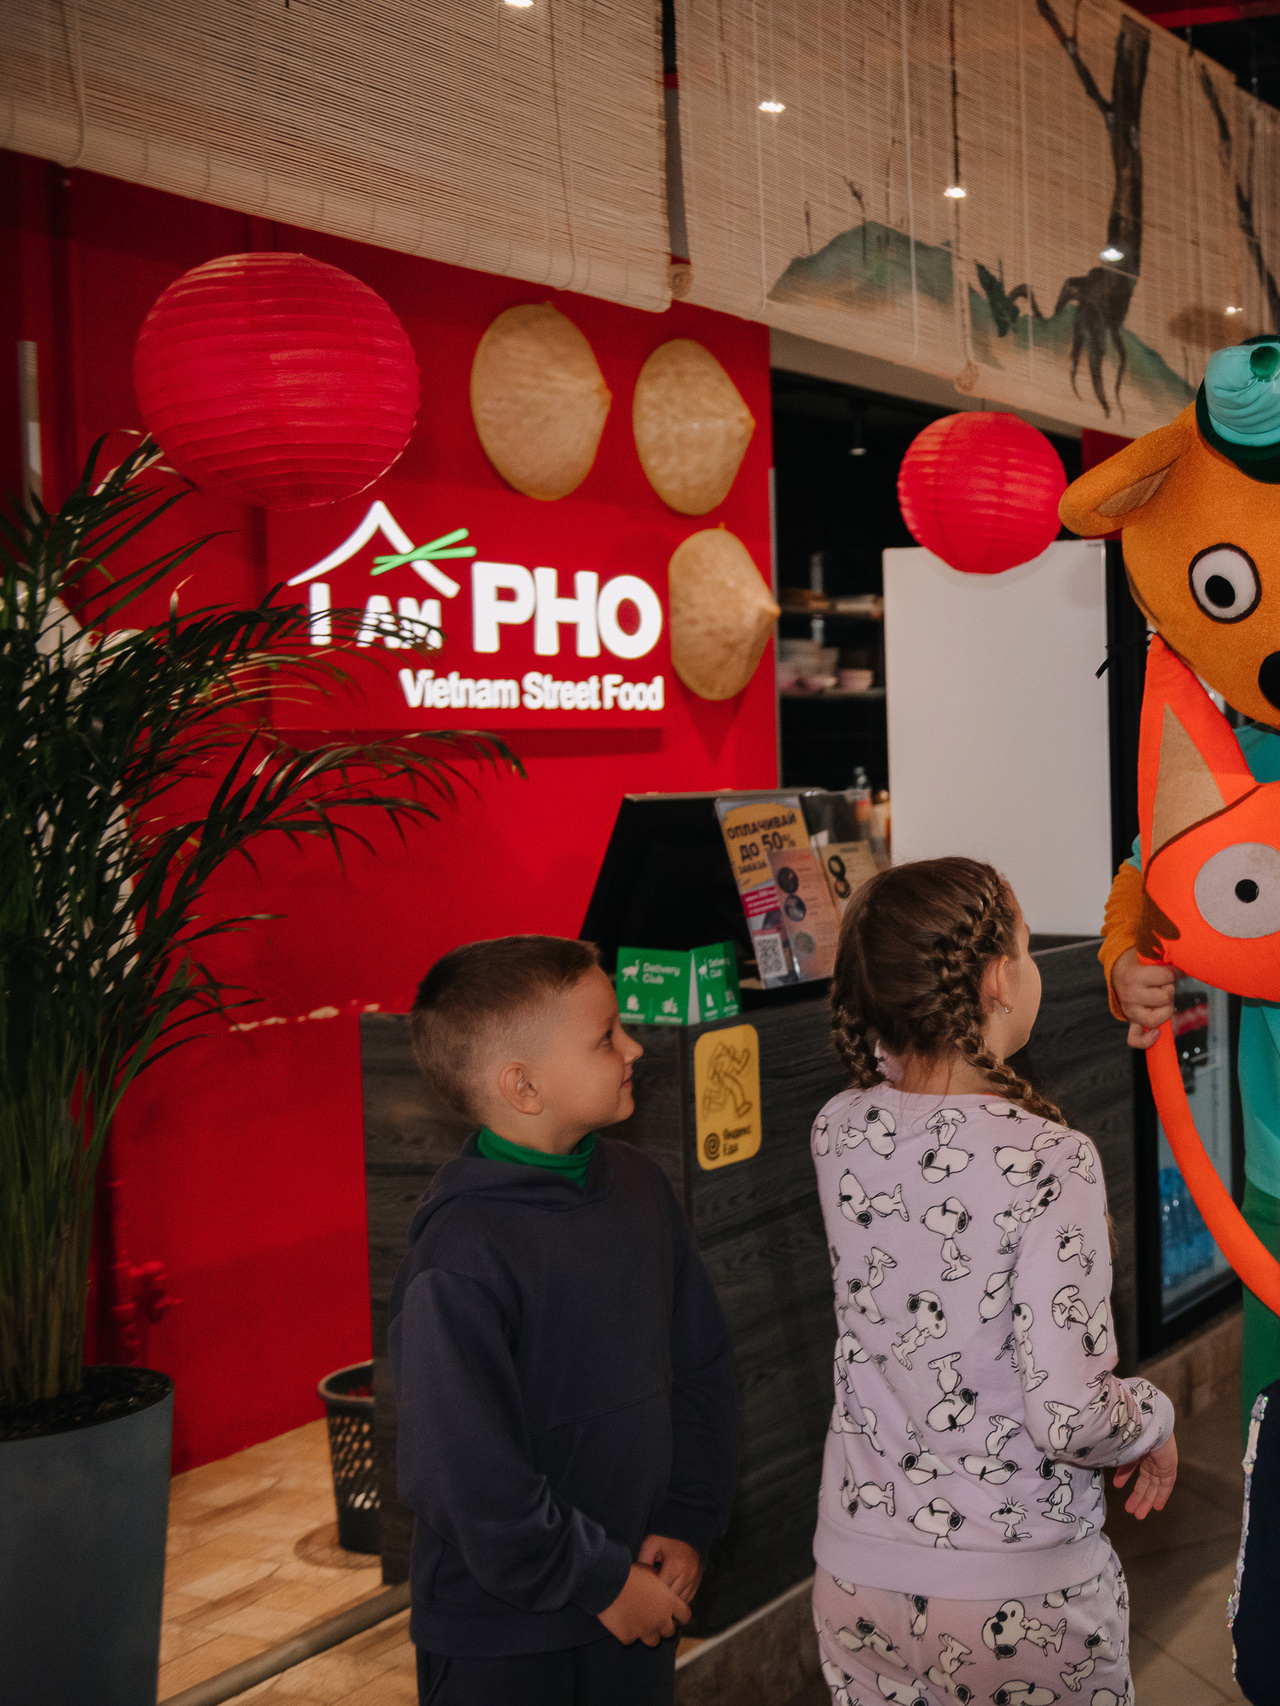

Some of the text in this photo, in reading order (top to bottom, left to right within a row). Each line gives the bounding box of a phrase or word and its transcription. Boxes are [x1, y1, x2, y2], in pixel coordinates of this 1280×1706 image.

[309, 582, 332, 646] I
[471, 560, 663, 660] PHO
[399, 667, 665, 712] Vietnam Street Food
[739, 841, 761, 863] ДО
